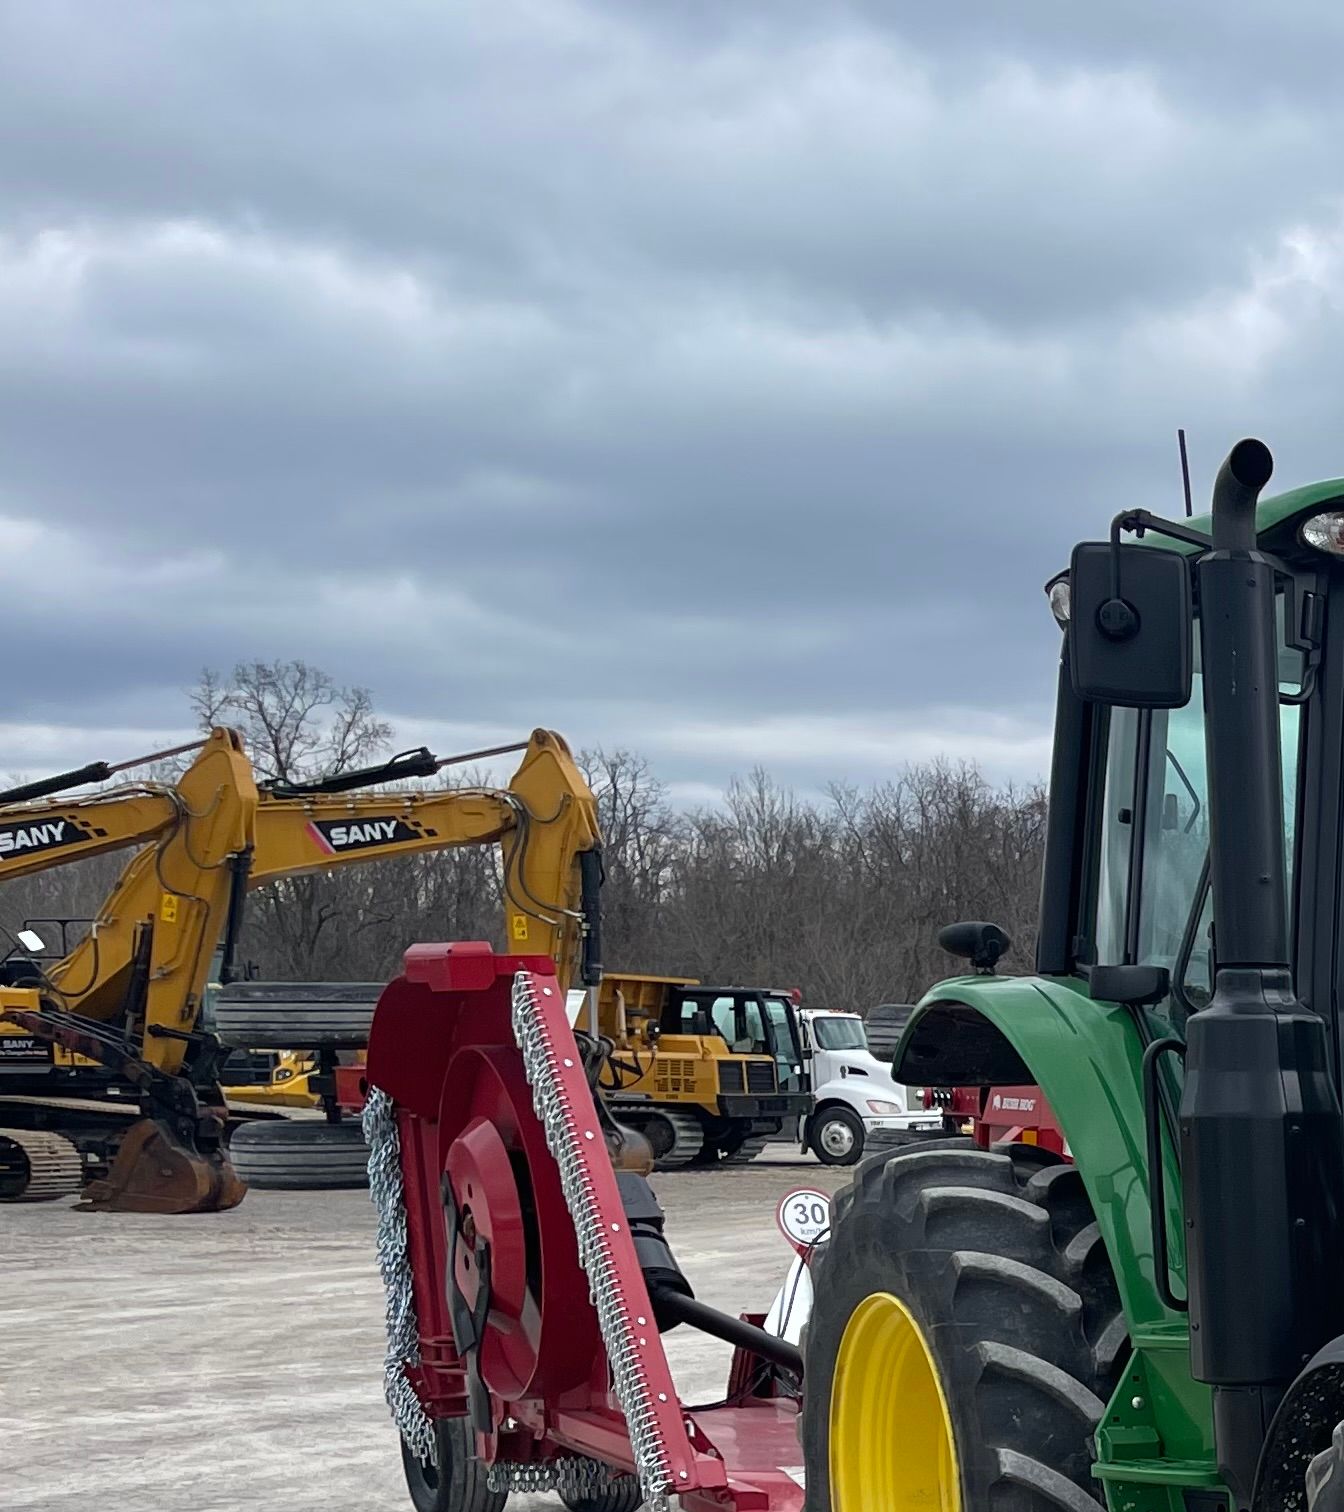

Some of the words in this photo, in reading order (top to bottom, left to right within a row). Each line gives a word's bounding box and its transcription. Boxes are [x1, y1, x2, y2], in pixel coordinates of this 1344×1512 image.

[0, 821, 65, 853] SANY
[330, 820, 397, 846] SANY
[793, 1203, 826, 1225] 30
